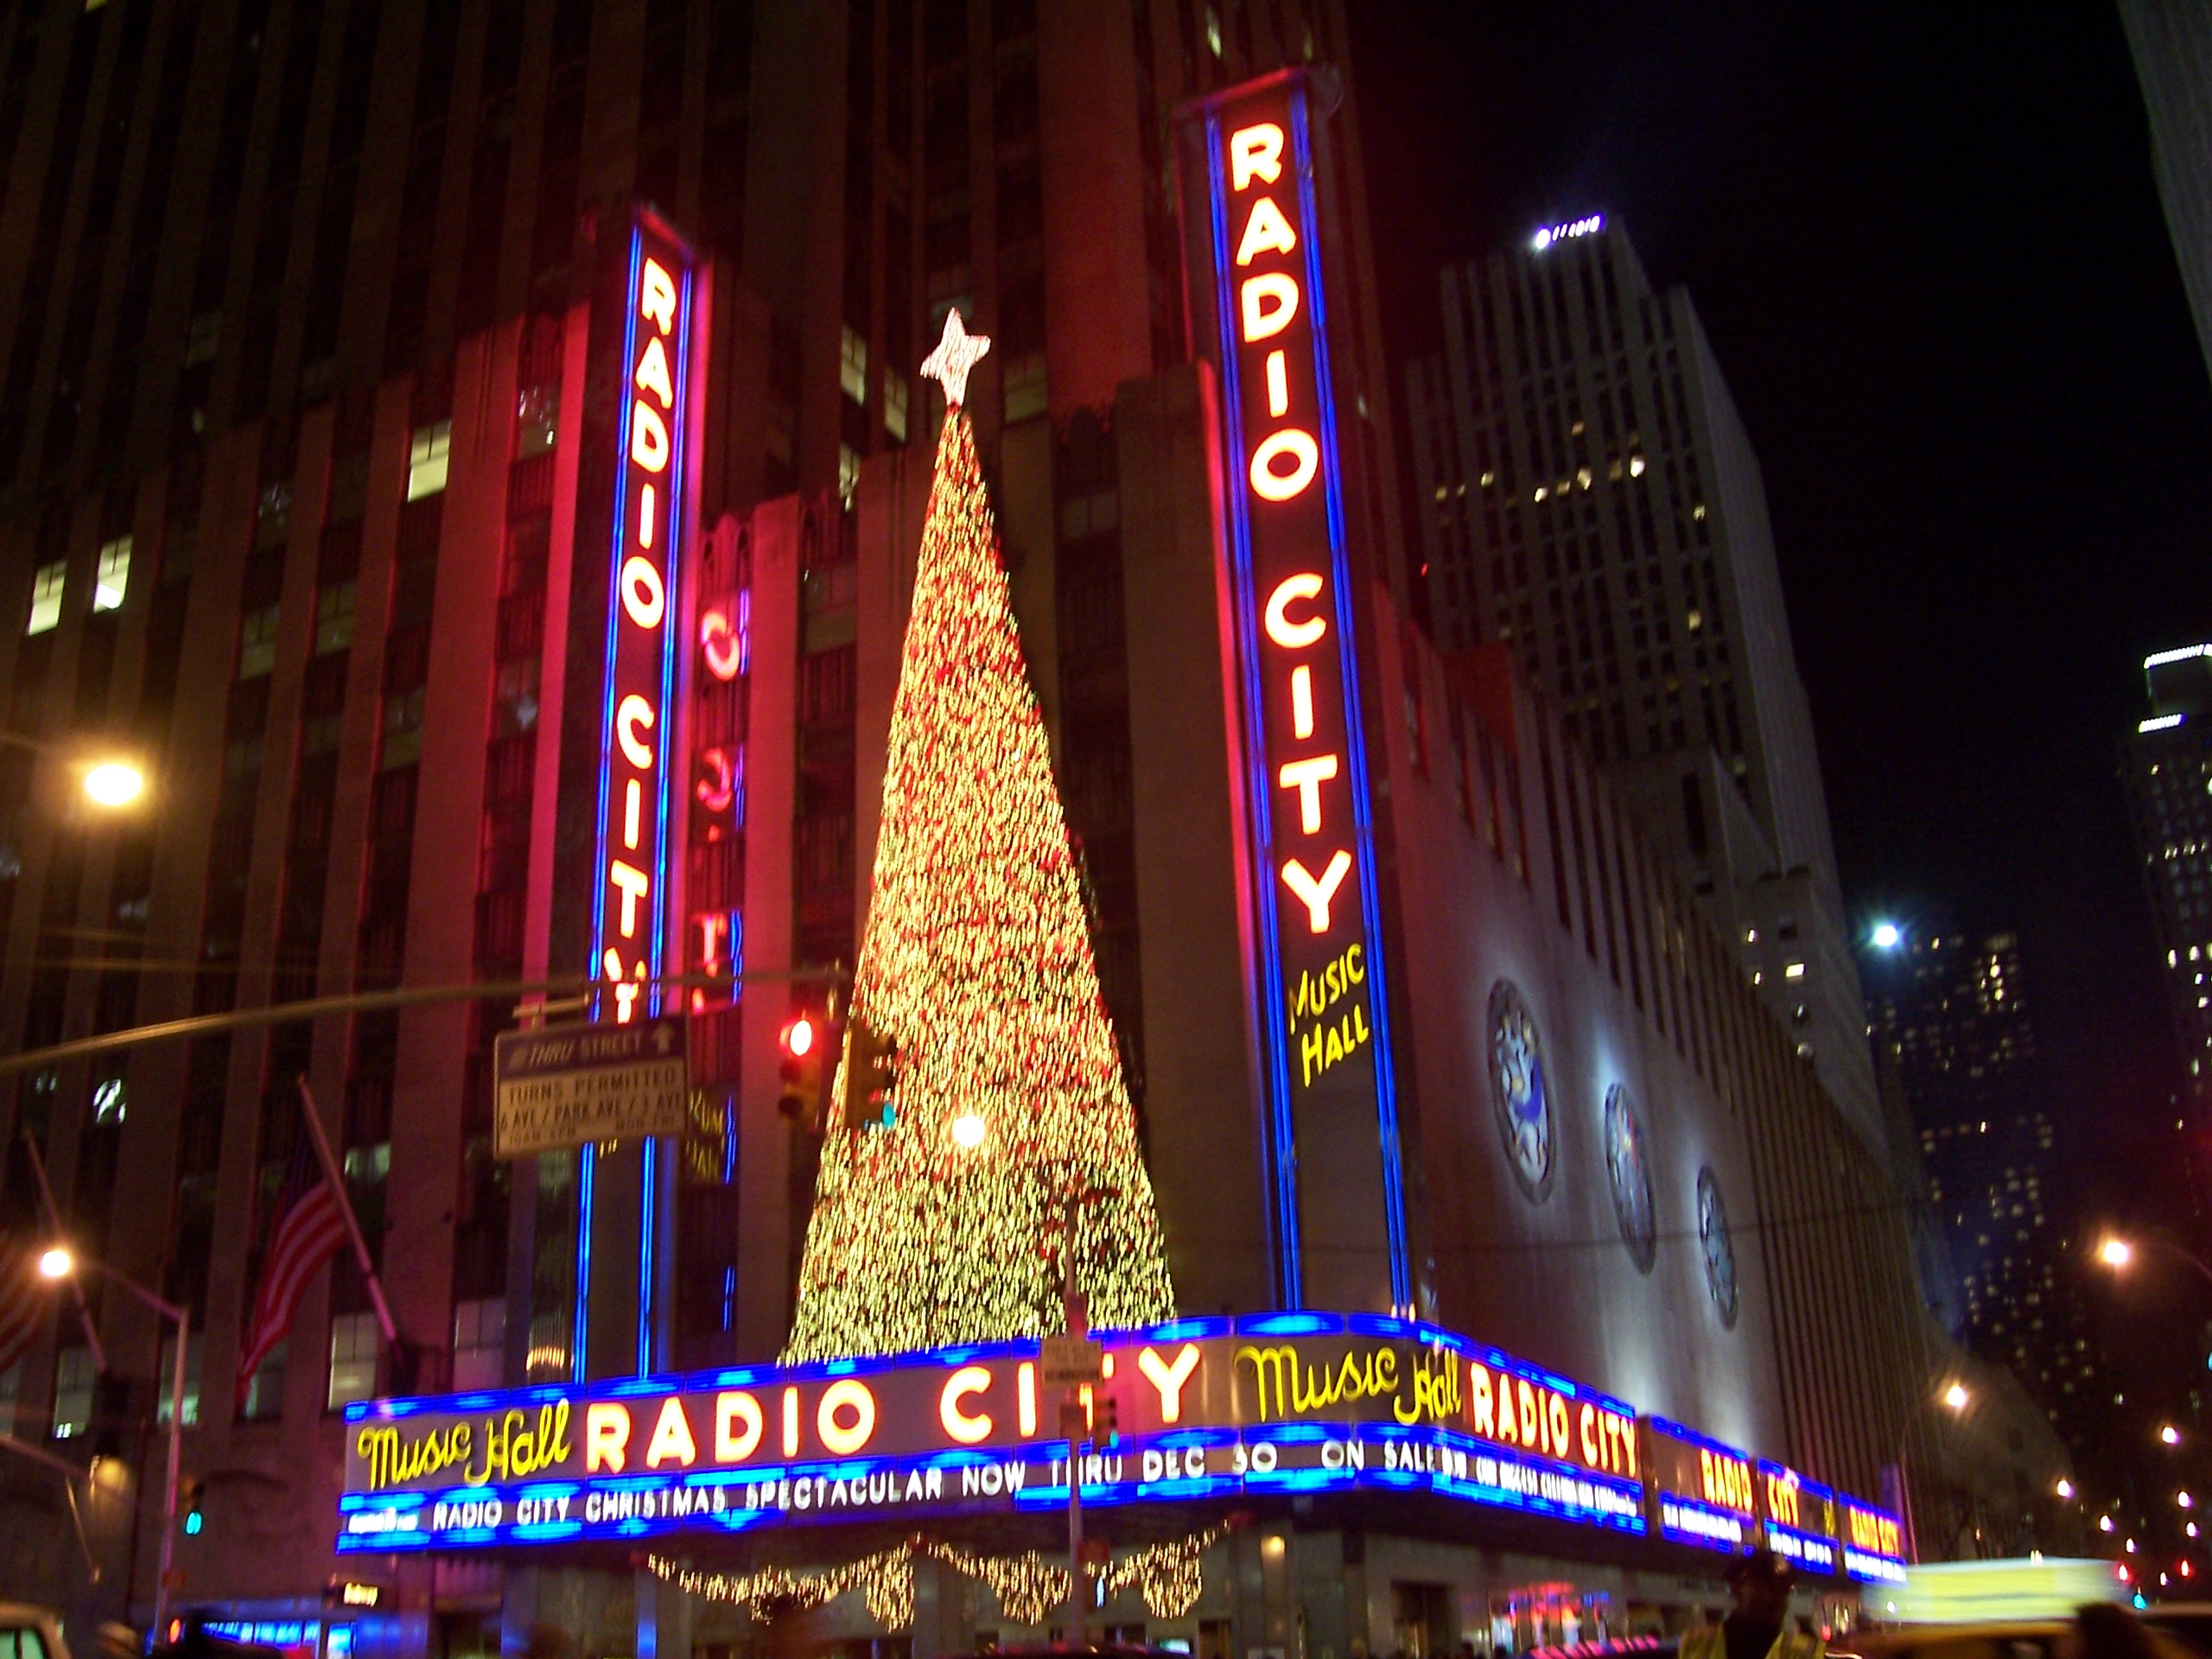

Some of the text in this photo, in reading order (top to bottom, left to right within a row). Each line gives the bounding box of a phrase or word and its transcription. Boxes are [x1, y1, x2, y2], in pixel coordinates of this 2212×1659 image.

[1230, 123, 1319, 502] RADIO
[620, 257, 677, 629] RADIO
[1264, 573, 1353, 935] CITY
[605, 694, 655, 1025] CITY
[1288, 943, 1365, 1037] MUSIC
[1301, 1004, 1369, 1089] HALL
[585, 1379, 876, 1473] RADIO
[1234, 1344, 1461, 1426] Music Hall
[1470, 1361, 1636, 1478] RADIO CITY
[358, 1397, 572, 1491] Music Hall
[433, 1497, 503, 1531] RADIO
[517, 1492, 570, 1527] CITY
[585, 1484, 726, 1523] CHRISTMAS
[745, 1466, 943, 1511] SPECTACULAR
[962, 1460, 1025, 1497] NOW
[1142, 1445, 1205, 1483] DEC
[1321, 1438, 1364, 1471] ON
[1384, 1438, 1435, 1474] SALE
[1700, 1447, 1753, 1513] RADIO
[1766, 1471, 1799, 1529] CITY
